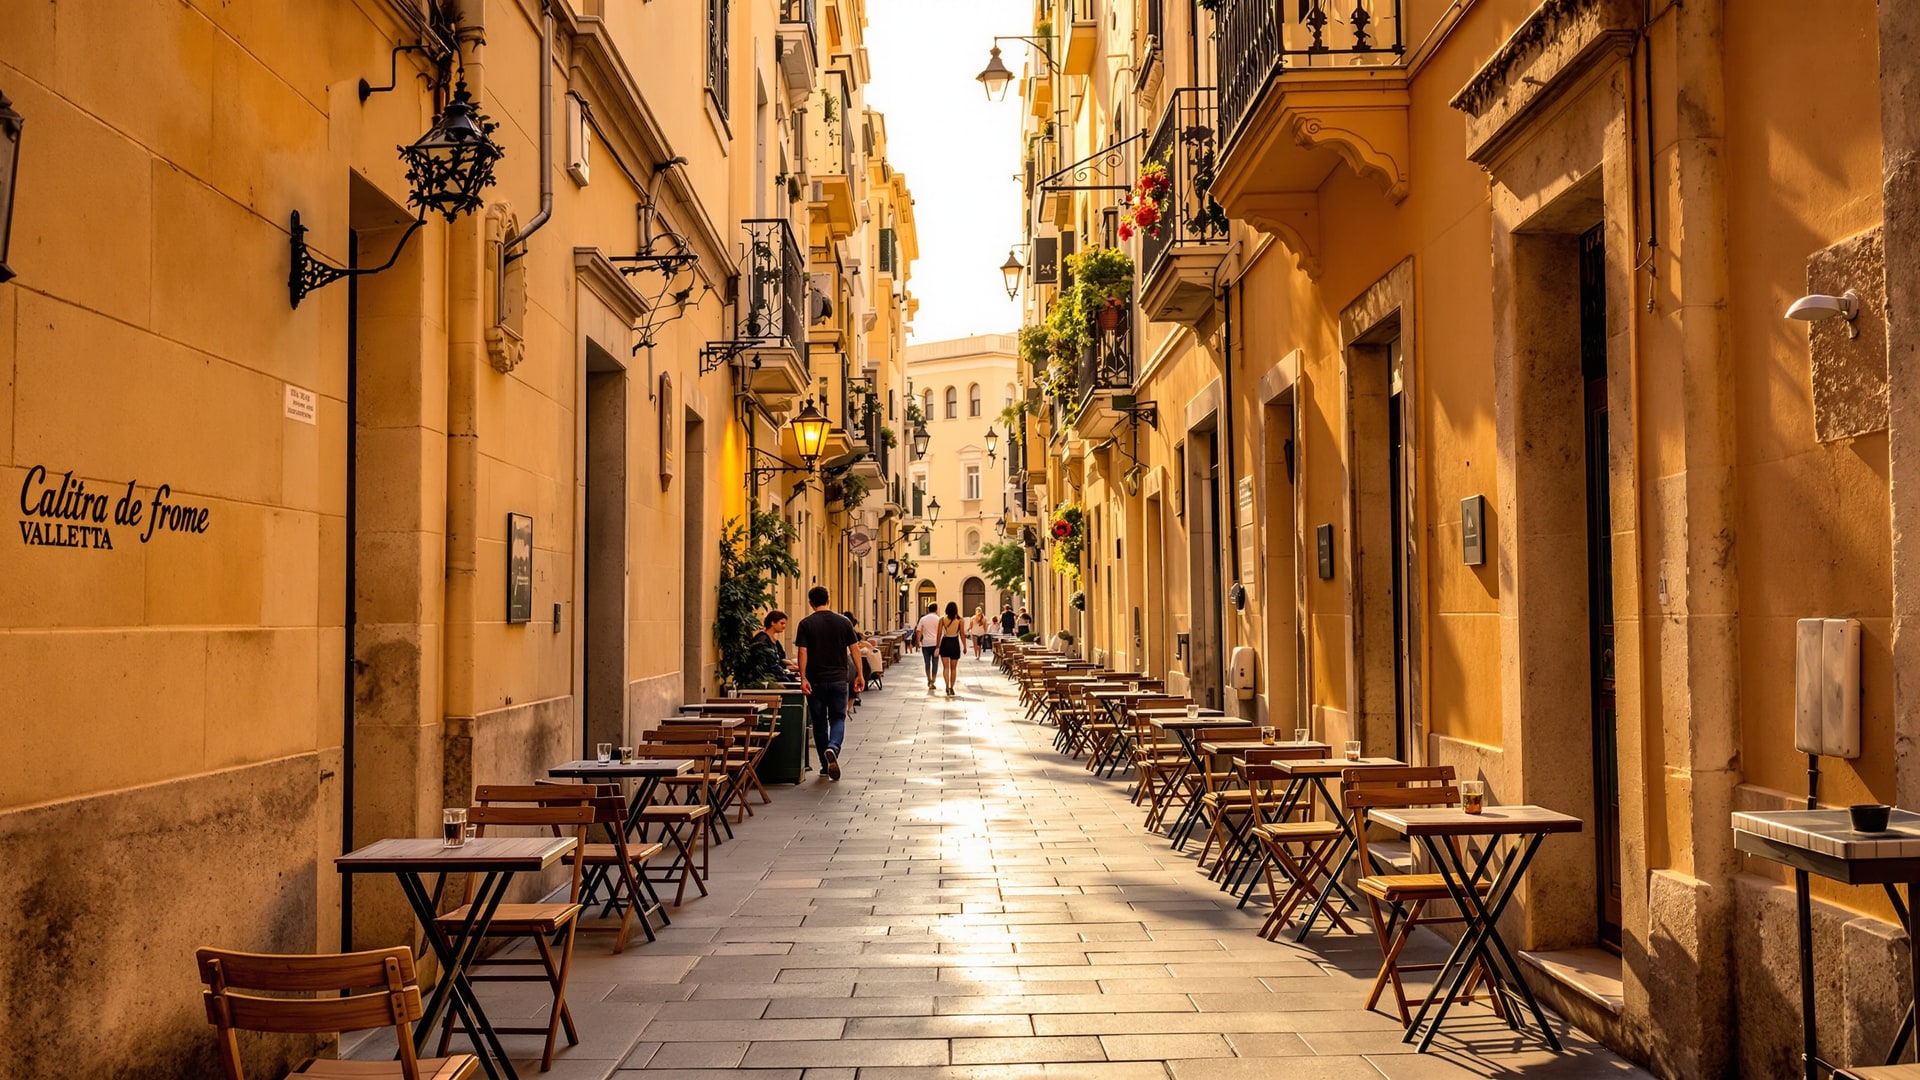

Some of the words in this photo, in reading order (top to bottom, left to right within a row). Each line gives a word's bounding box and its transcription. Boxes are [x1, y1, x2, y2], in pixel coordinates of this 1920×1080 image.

[114, 479, 143, 526] de
[140, 484, 210, 543] frome
[19, 520, 113, 550] VALLETTA
